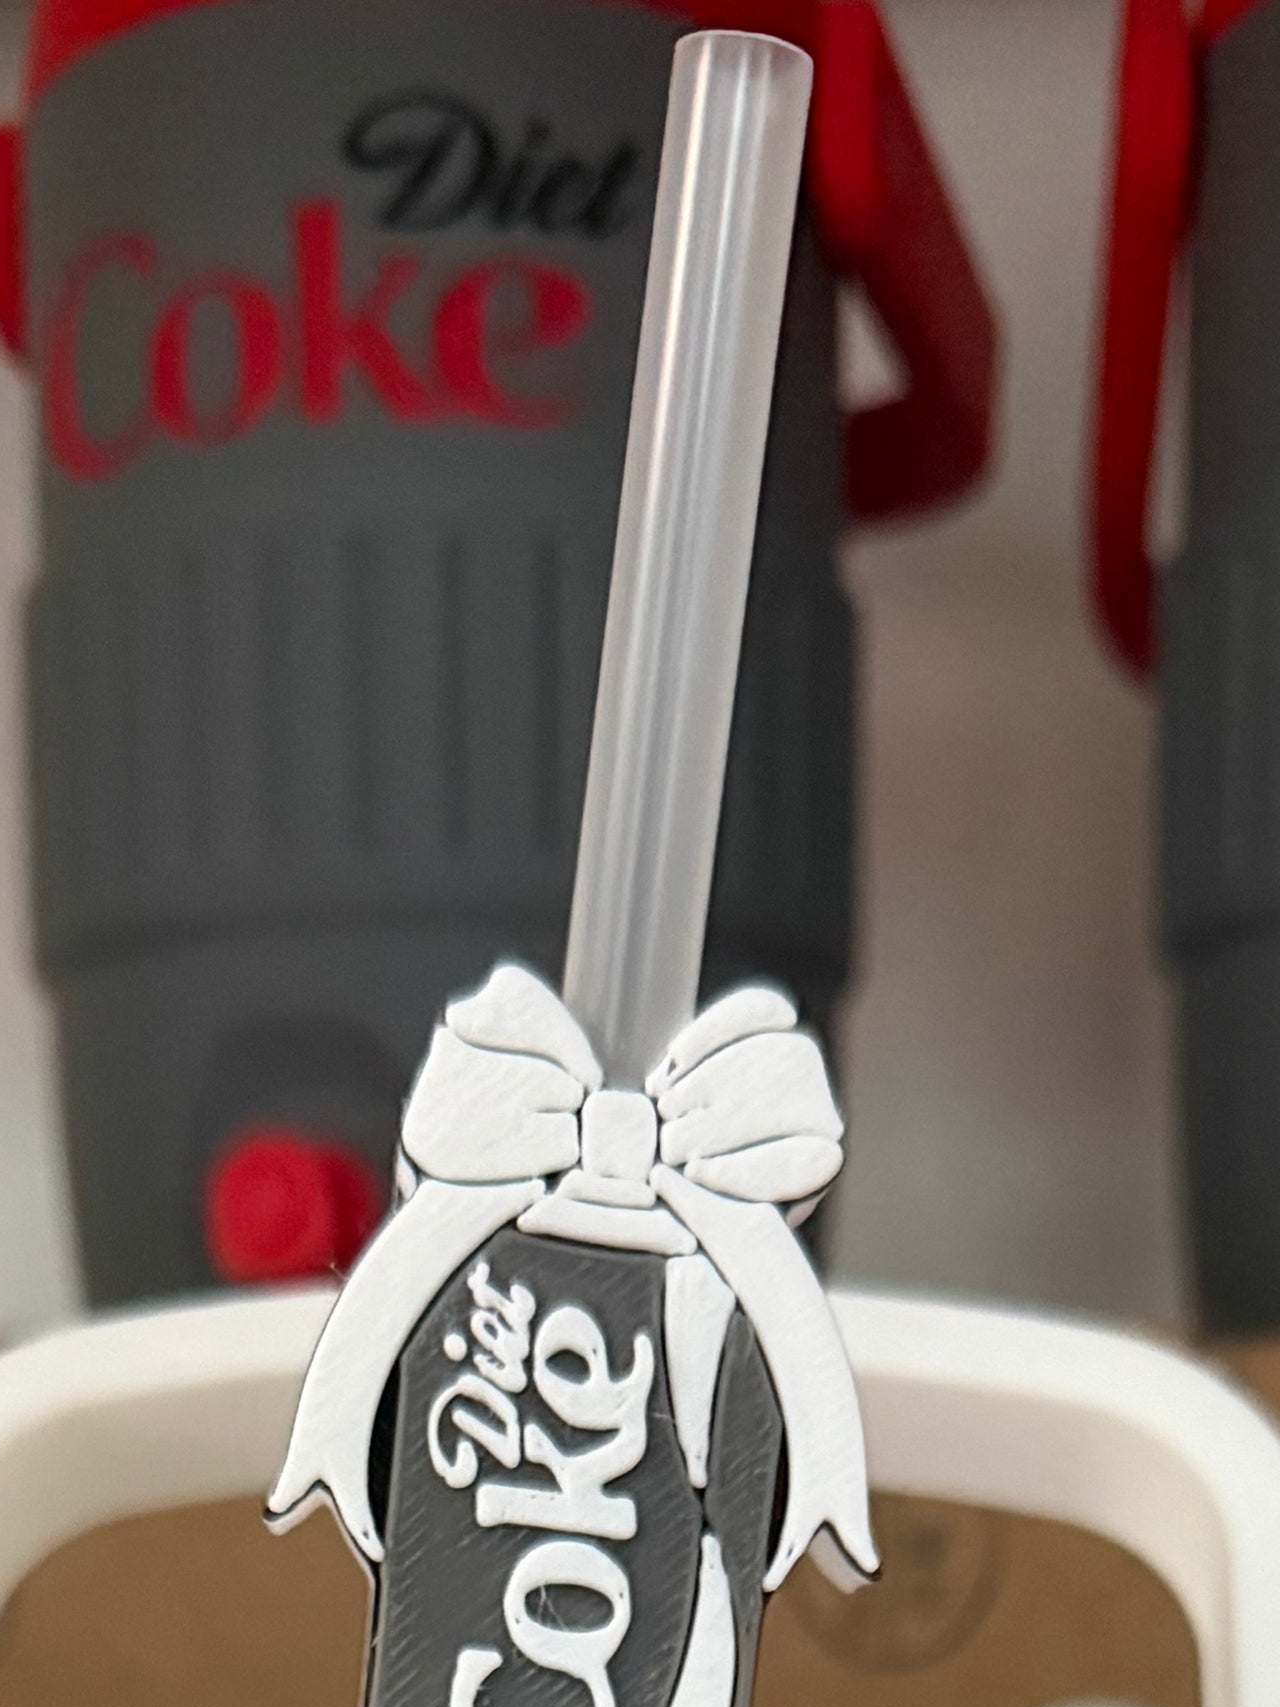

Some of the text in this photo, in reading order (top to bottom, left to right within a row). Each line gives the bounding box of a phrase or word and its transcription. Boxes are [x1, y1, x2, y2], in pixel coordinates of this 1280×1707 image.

[341, 86, 642, 240] Diet
[42, 197, 592, 481] Coke
[429, 1261, 536, 1489] Diet
